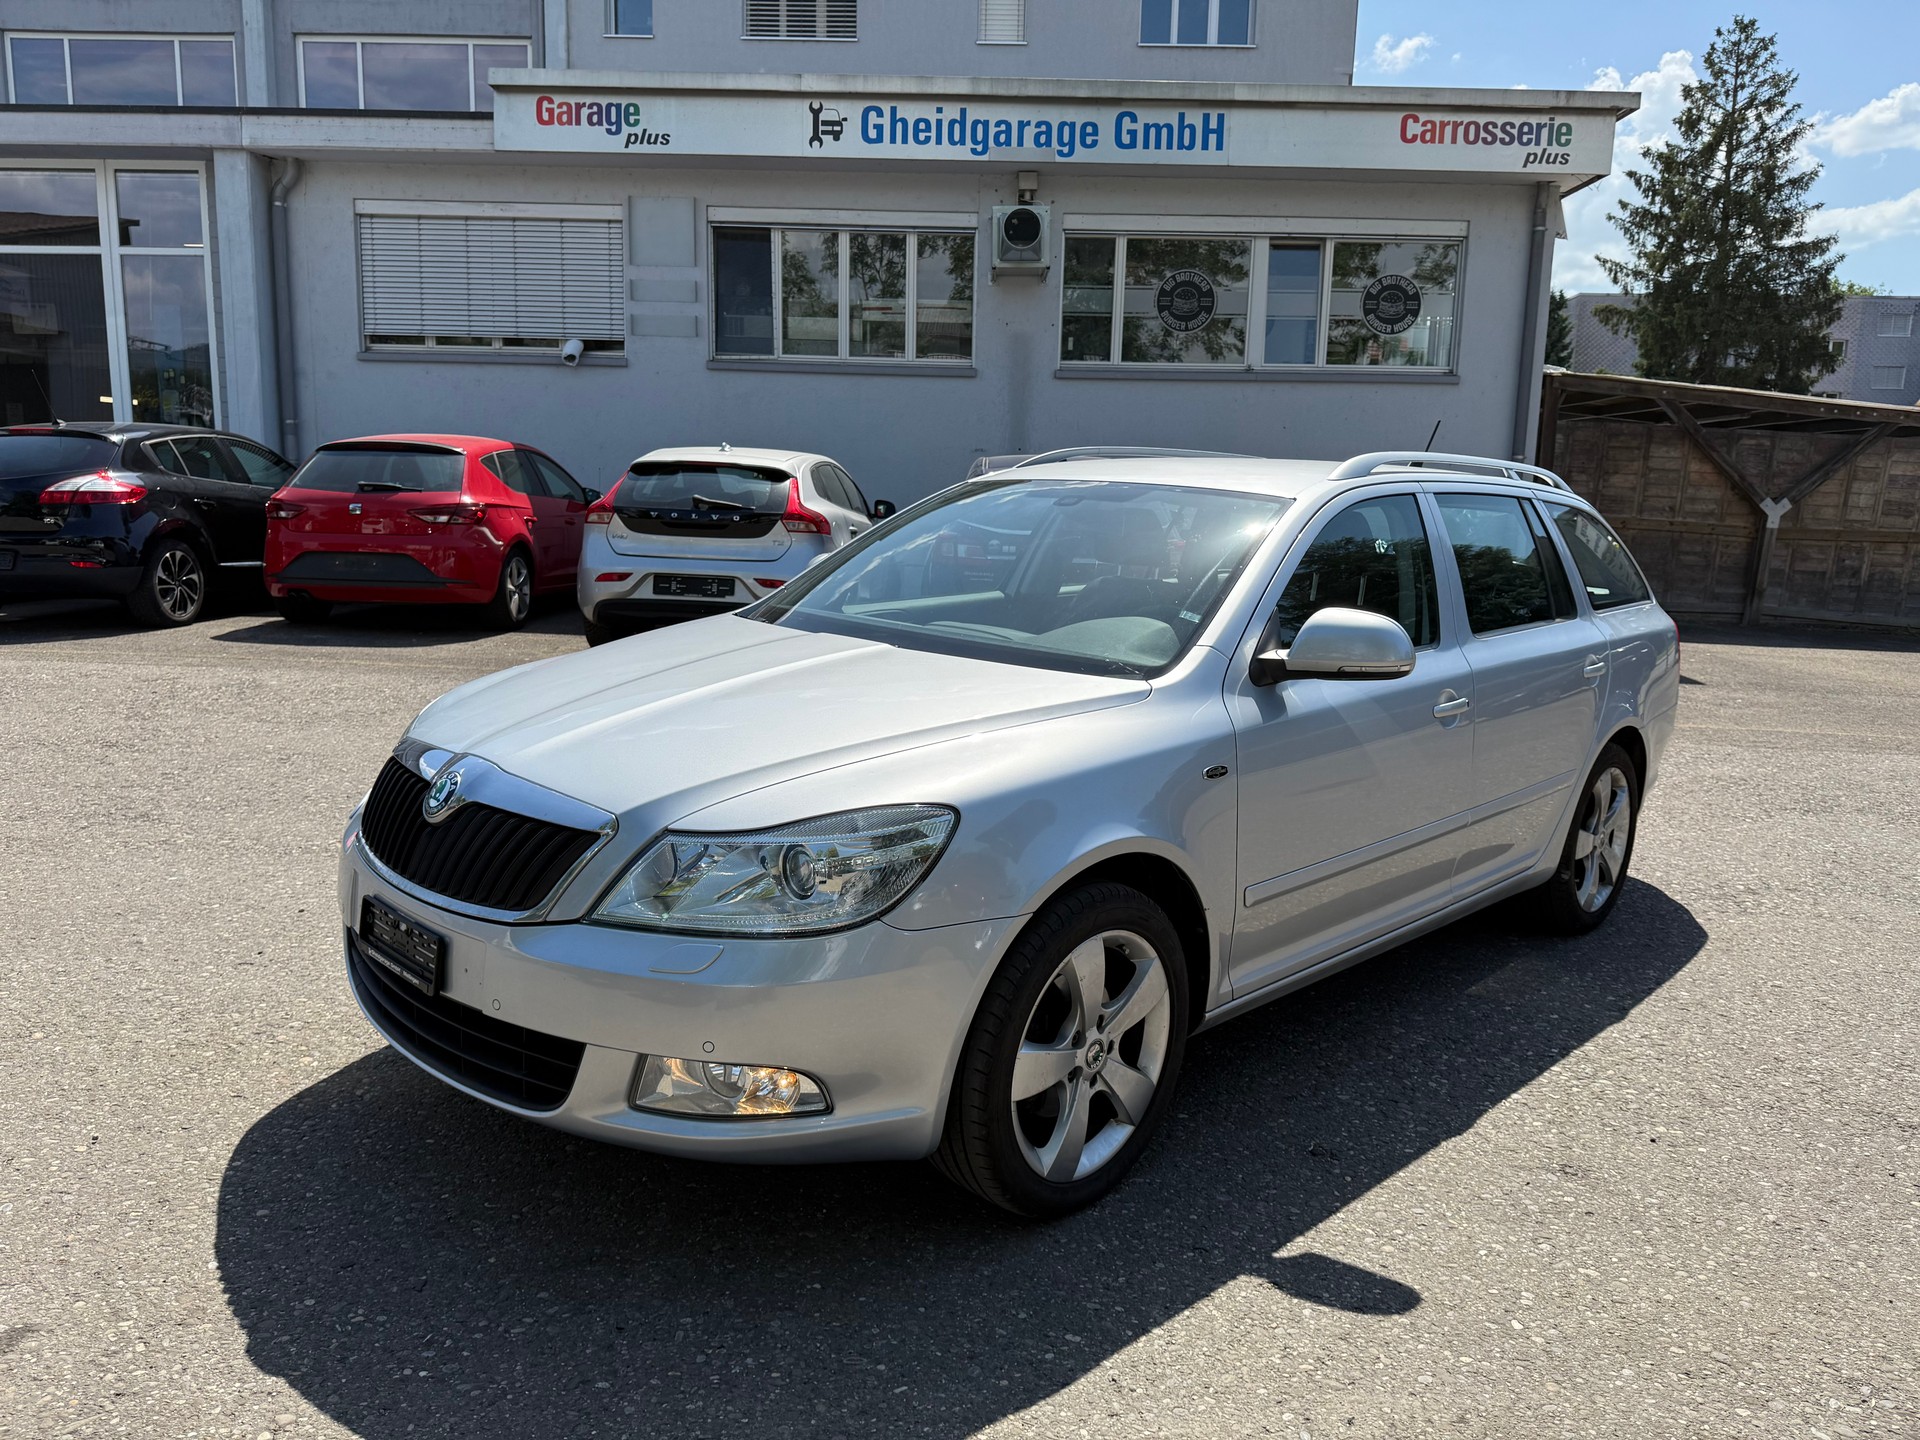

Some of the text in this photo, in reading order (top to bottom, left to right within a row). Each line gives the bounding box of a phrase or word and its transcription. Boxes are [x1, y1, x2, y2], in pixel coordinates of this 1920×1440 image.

[536, 96, 640, 135] Garage
[624, 128, 671, 148] plus
[861, 105, 1225, 158] Gheidgarage GmbH
[1400, 113, 1573, 147] Carrosserie
[1522, 148, 1571, 168] plus
[1163, 272, 1210, 292] BIG BROTHERS
[1369, 276, 1416, 295] BIG BROTHERS
[1161, 310, 1209, 330] BURGER HOUSE
[1366, 313, 1416, 333] BURGER HOUSE
[650, 511, 740, 521] VOLVO
